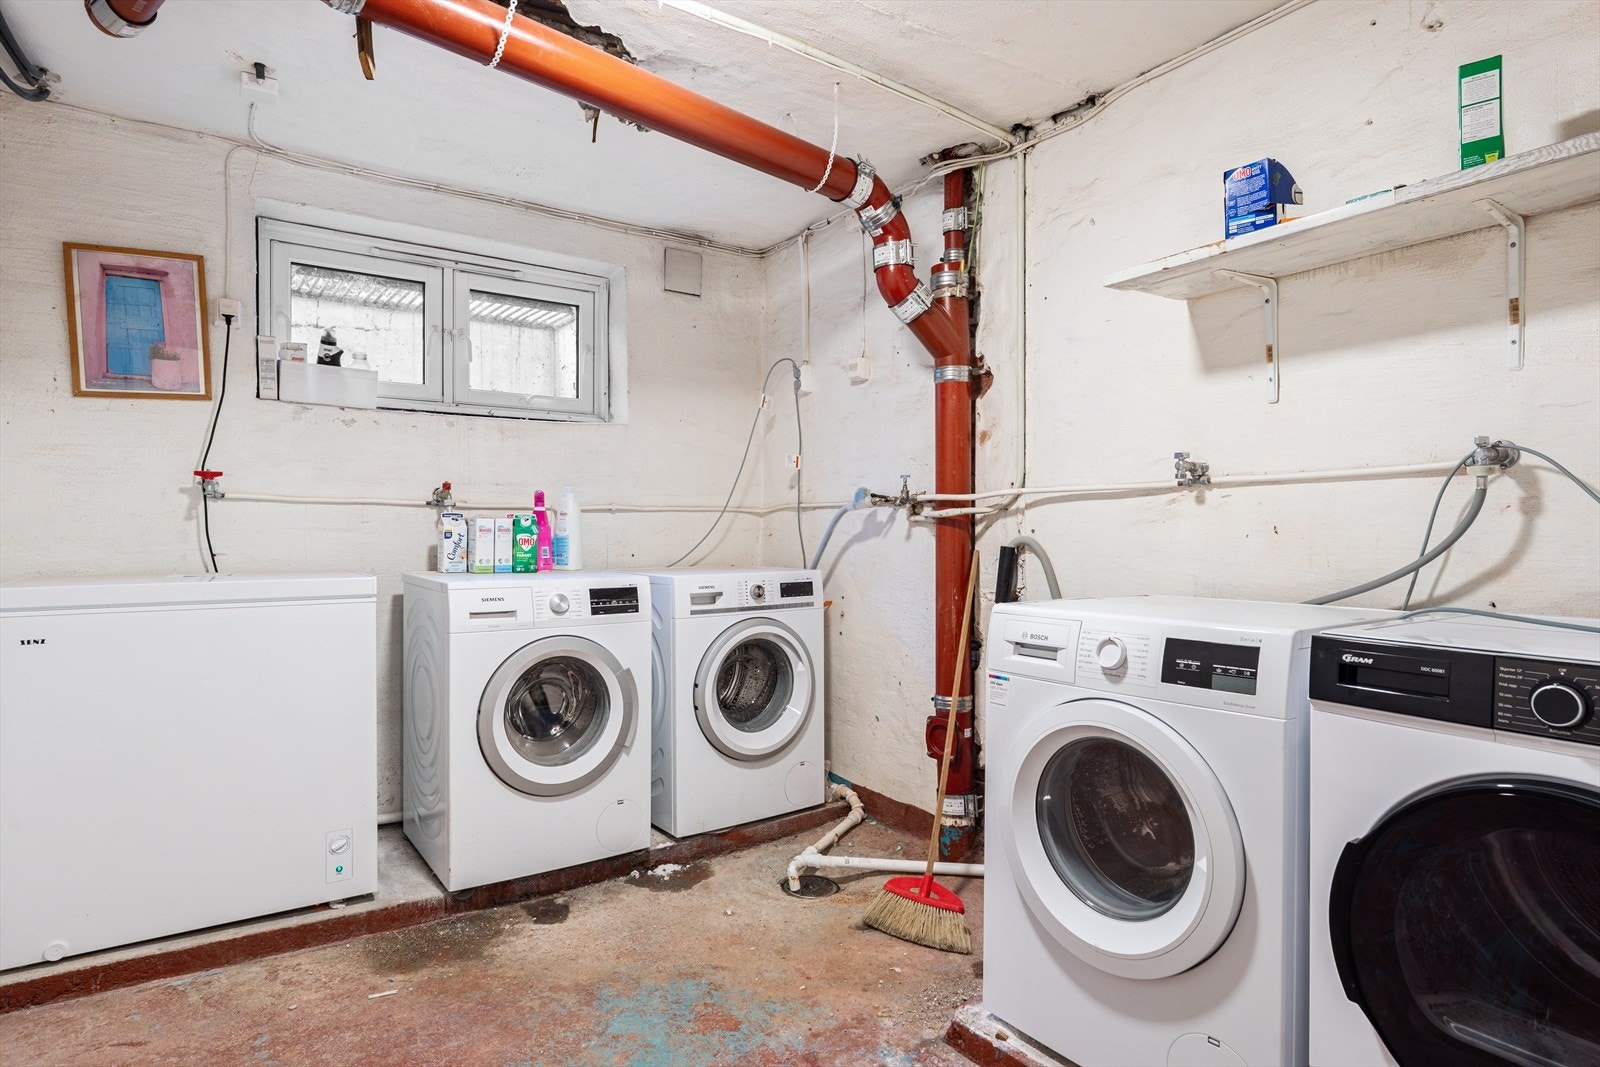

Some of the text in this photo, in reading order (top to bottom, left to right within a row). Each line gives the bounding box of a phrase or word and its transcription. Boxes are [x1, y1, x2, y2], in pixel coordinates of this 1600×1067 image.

[1234, 167, 1251, 181] OMO
[447, 533, 465, 560] Comfort
[518, 538, 535, 546] OMO
[1029, 633, 1048, 641] BOSCH
[1342, 654, 1374, 664] GRAM
